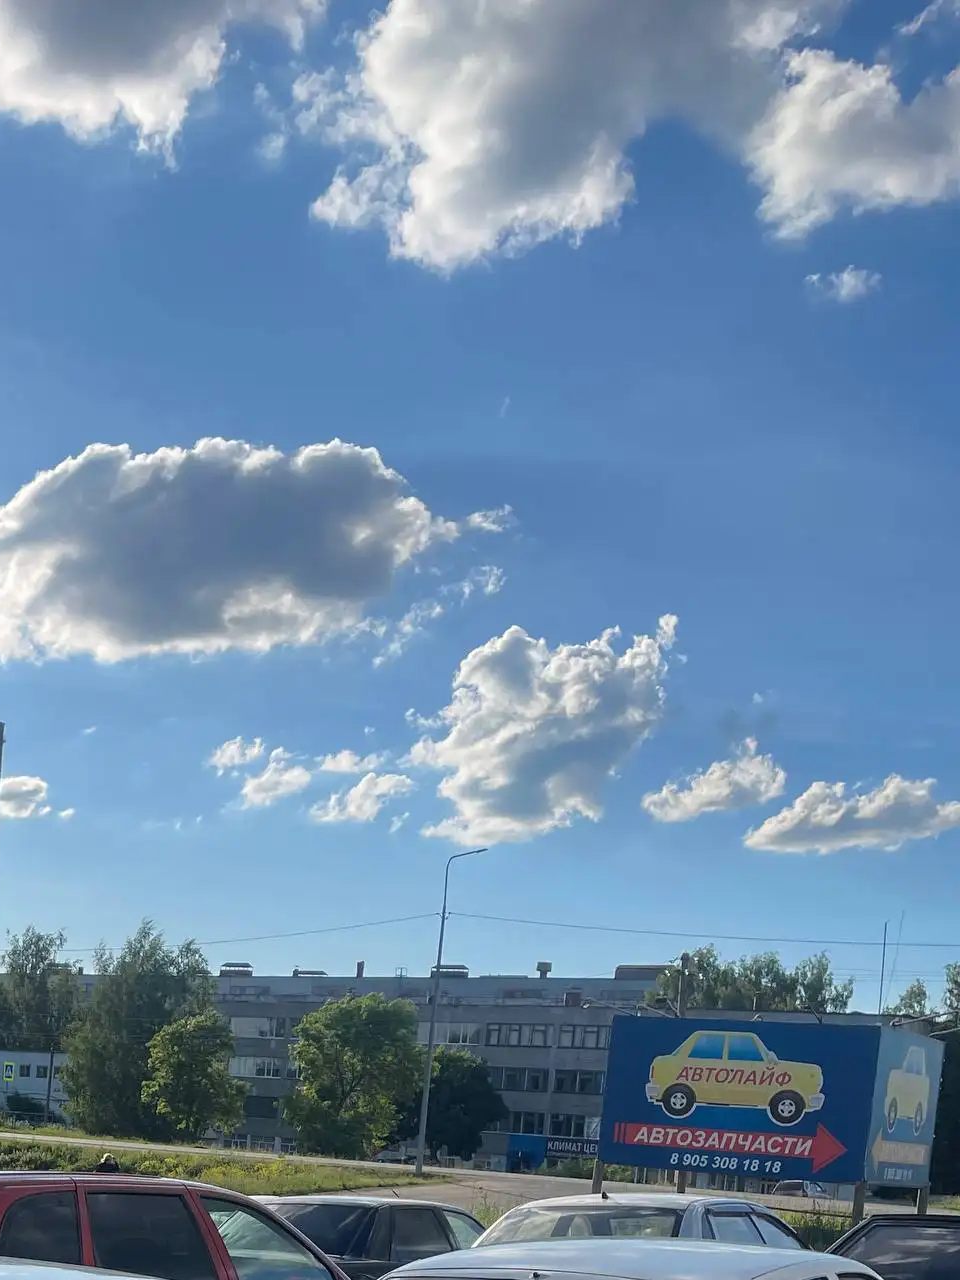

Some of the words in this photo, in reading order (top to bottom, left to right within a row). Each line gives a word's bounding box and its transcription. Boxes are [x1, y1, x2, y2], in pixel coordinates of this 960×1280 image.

[675, 1066, 792, 1087] АВТОЛАЙФ
[547, 1141, 581, 1152] КЛИМАТ
[634, 1126, 814, 1156] АВТОЗАПЧАСТИ
[669, 1153, 678, 1165] 8
[682, 1154, 709, 1168] 905
[711, 1156, 738, 1170] 308
[742, 1158, 760, 1172] 18
[764, 1160, 782, 1174] 18
